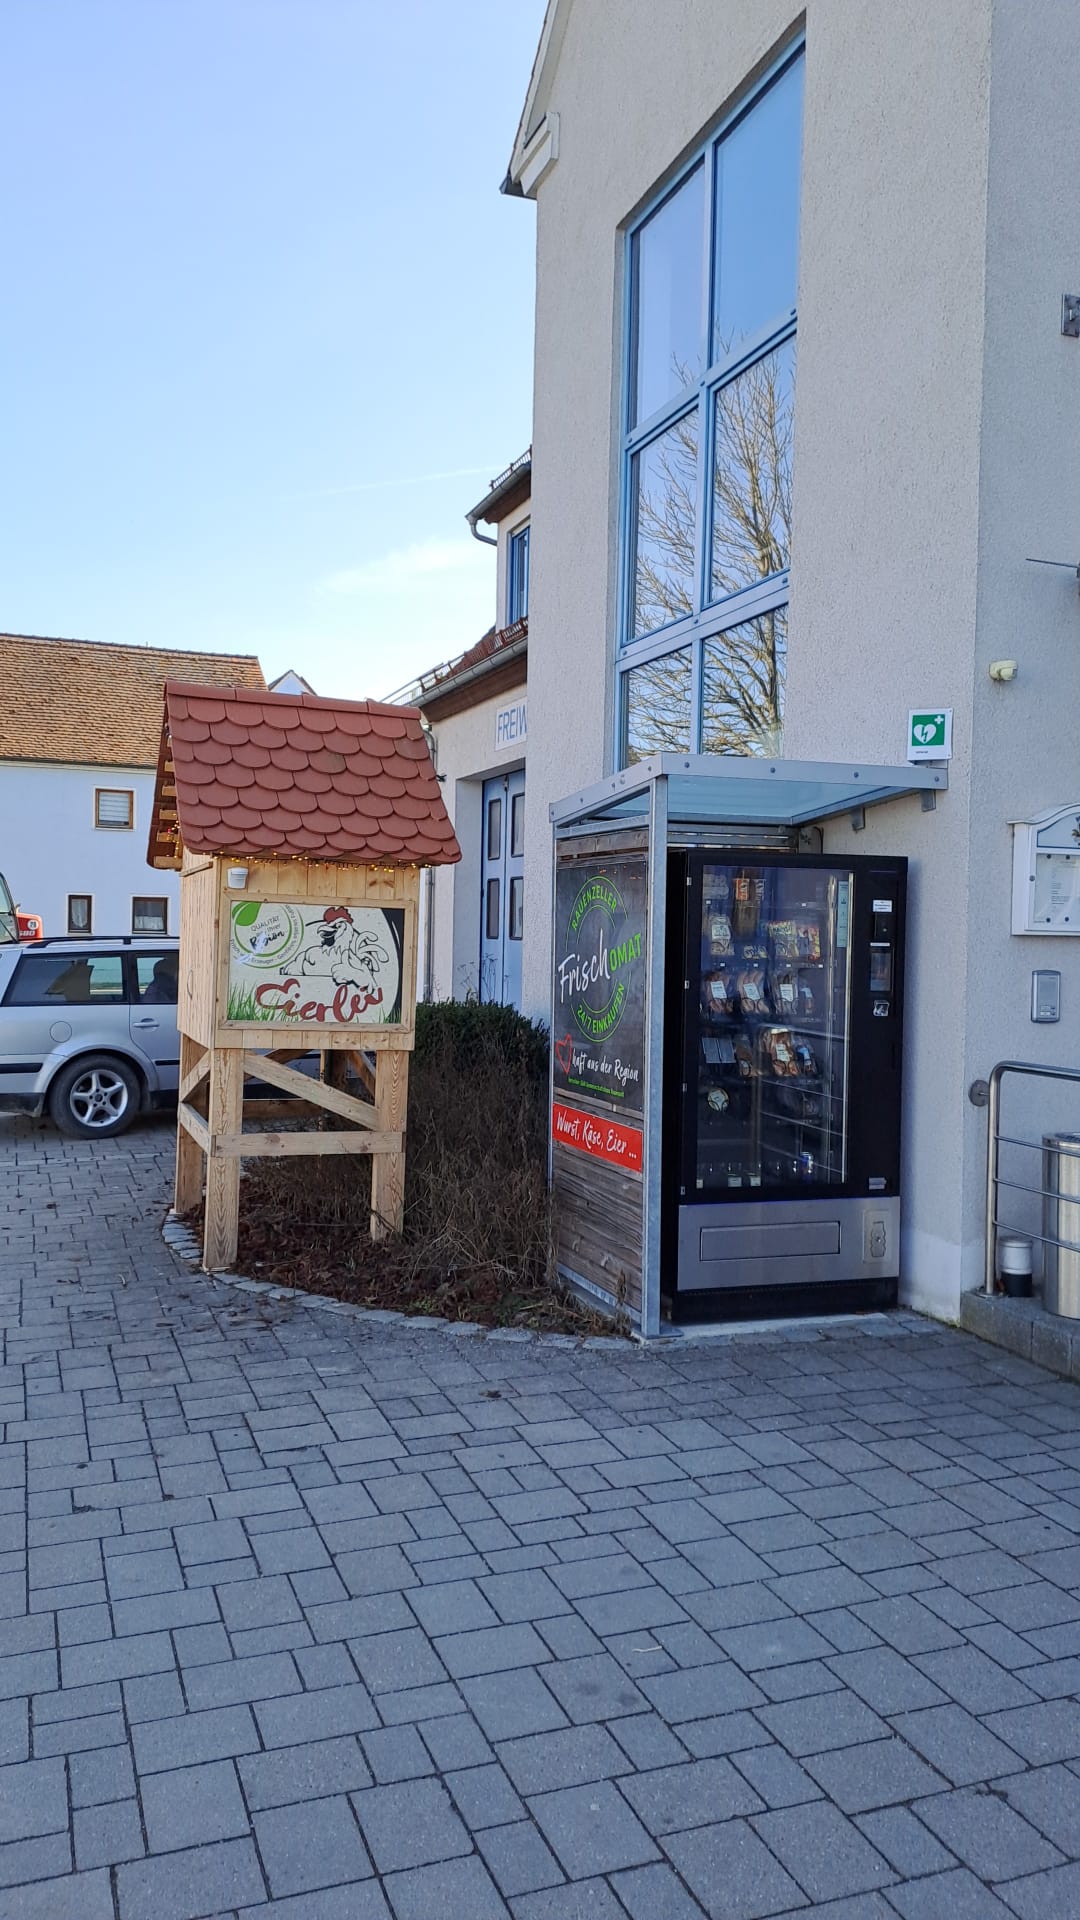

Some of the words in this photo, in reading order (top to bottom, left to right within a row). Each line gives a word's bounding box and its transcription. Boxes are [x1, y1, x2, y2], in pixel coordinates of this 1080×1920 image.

[571, 885, 617, 930] RAUENZELLER
[577, 1004, 592, 1030] 24/7
[592, 983, 625, 1034] EINKAUFEN
[572, 1048, 588, 1075] haft
[587, 1059, 598, 1072] aus
[600, 1055, 613, 1073] der
[614, 1058, 639, 1087] Region
[556, 1111, 581, 1140] Wurst,
[583, 1120, 604, 1150] Käse,
[606, 1128, 627, 1154] Eier
